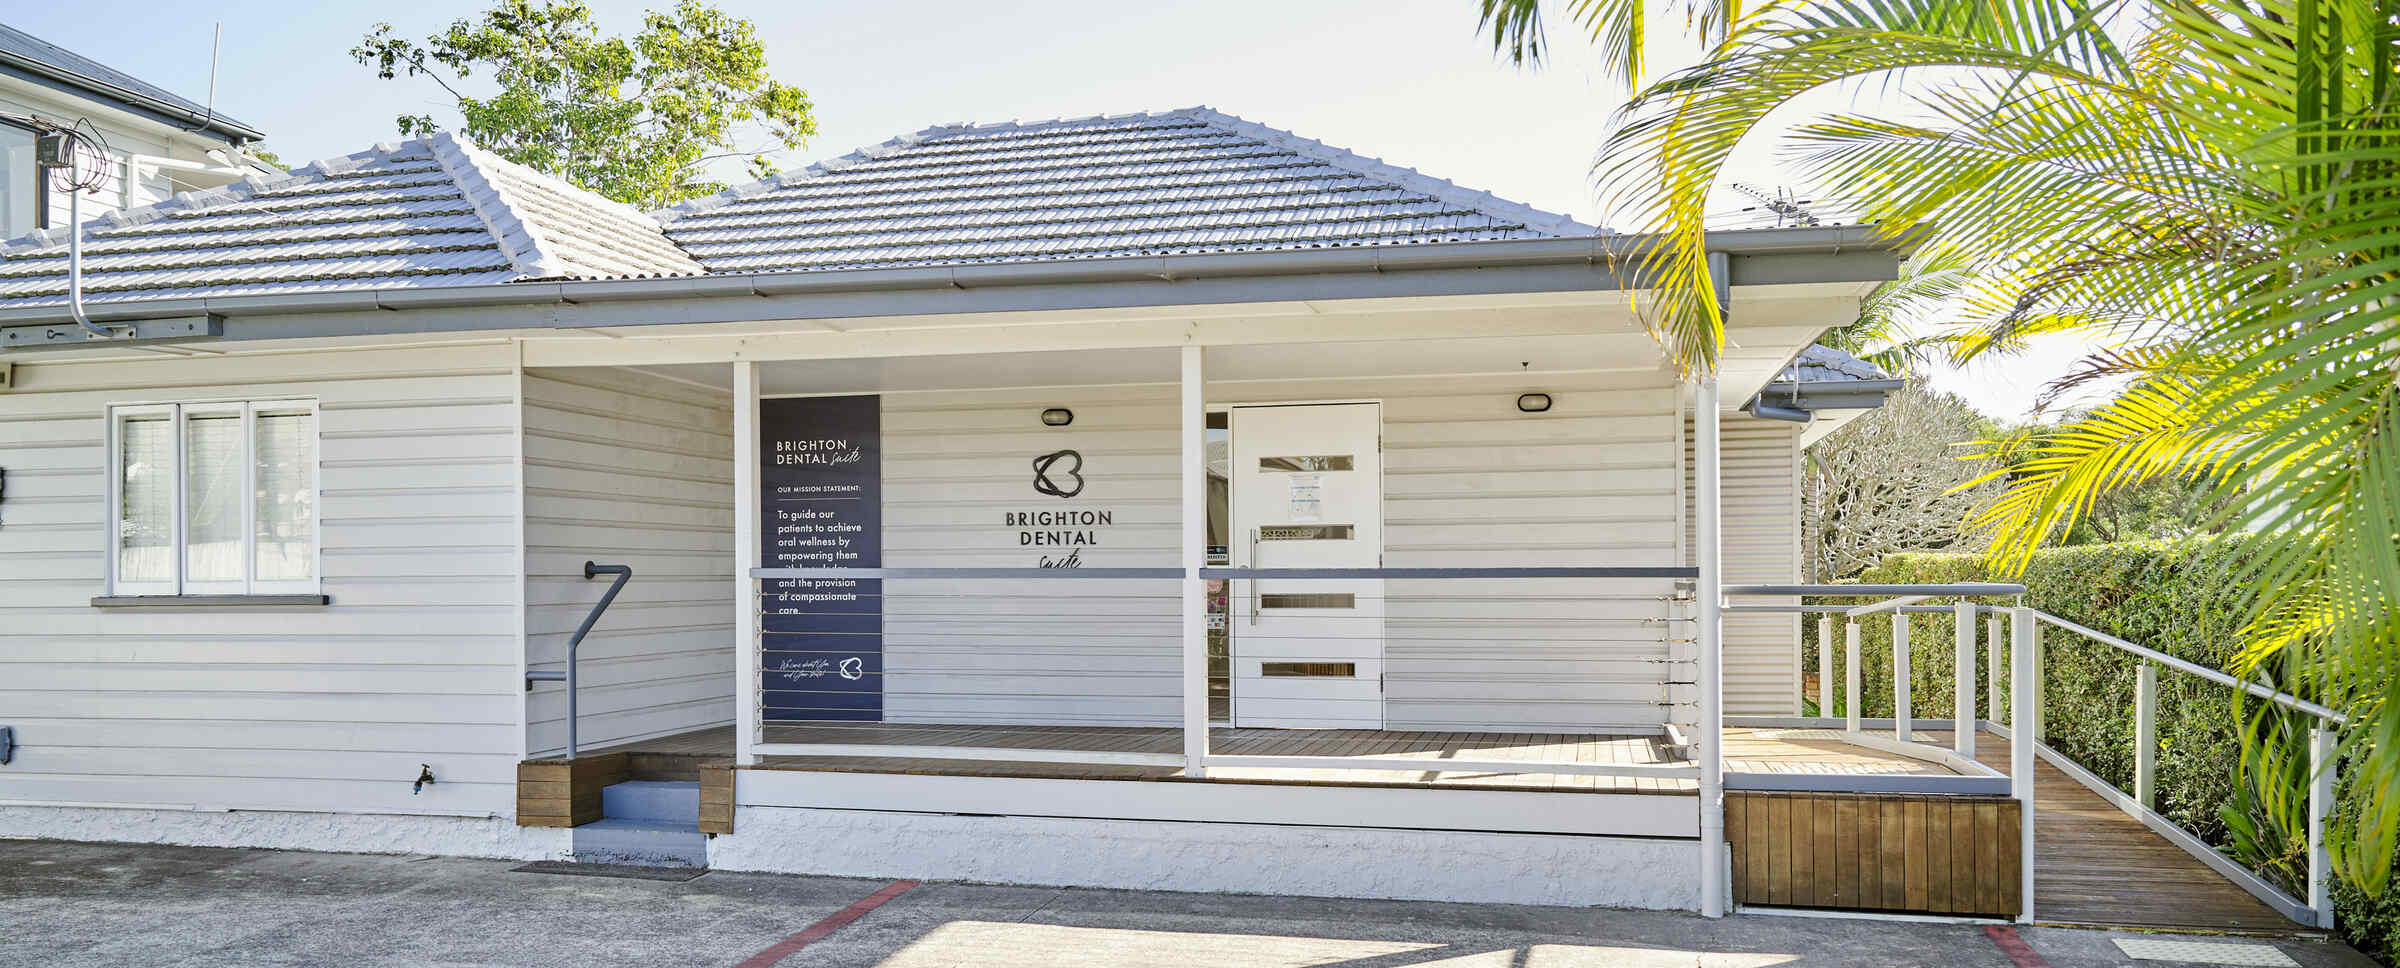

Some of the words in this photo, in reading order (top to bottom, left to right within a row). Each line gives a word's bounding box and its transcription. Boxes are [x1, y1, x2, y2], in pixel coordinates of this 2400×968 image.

[776, 440, 847, 451] BRIGHTON
[776, 453, 828, 465] DENTAL
[777, 510, 789, 519] To
[791, 508, 816, 521] guide
[818, 511, 834, 519] our
[1006, 511, 1112, 526] BRIGHTON
[778, 524, 813, 535] patients
[815, 524, 825, 532] to
[827, 522, 862, 532] achieve
[778, 536, 796, 546] oral
[799, 536, 836, 546] wellness
[838, 536, 850, 548] by
[1020, 531, 1097, 545] DENTAL
[778, 551, 833, 562] empowering
[836, 550, 858, 559] them
[778, 578, 796, 587] and
[798, 578, 812, 587] the
[815, 578, 856, 589] provision
[778, 591, 788, 601] of
[790, 592, 857, 604] compassionate
